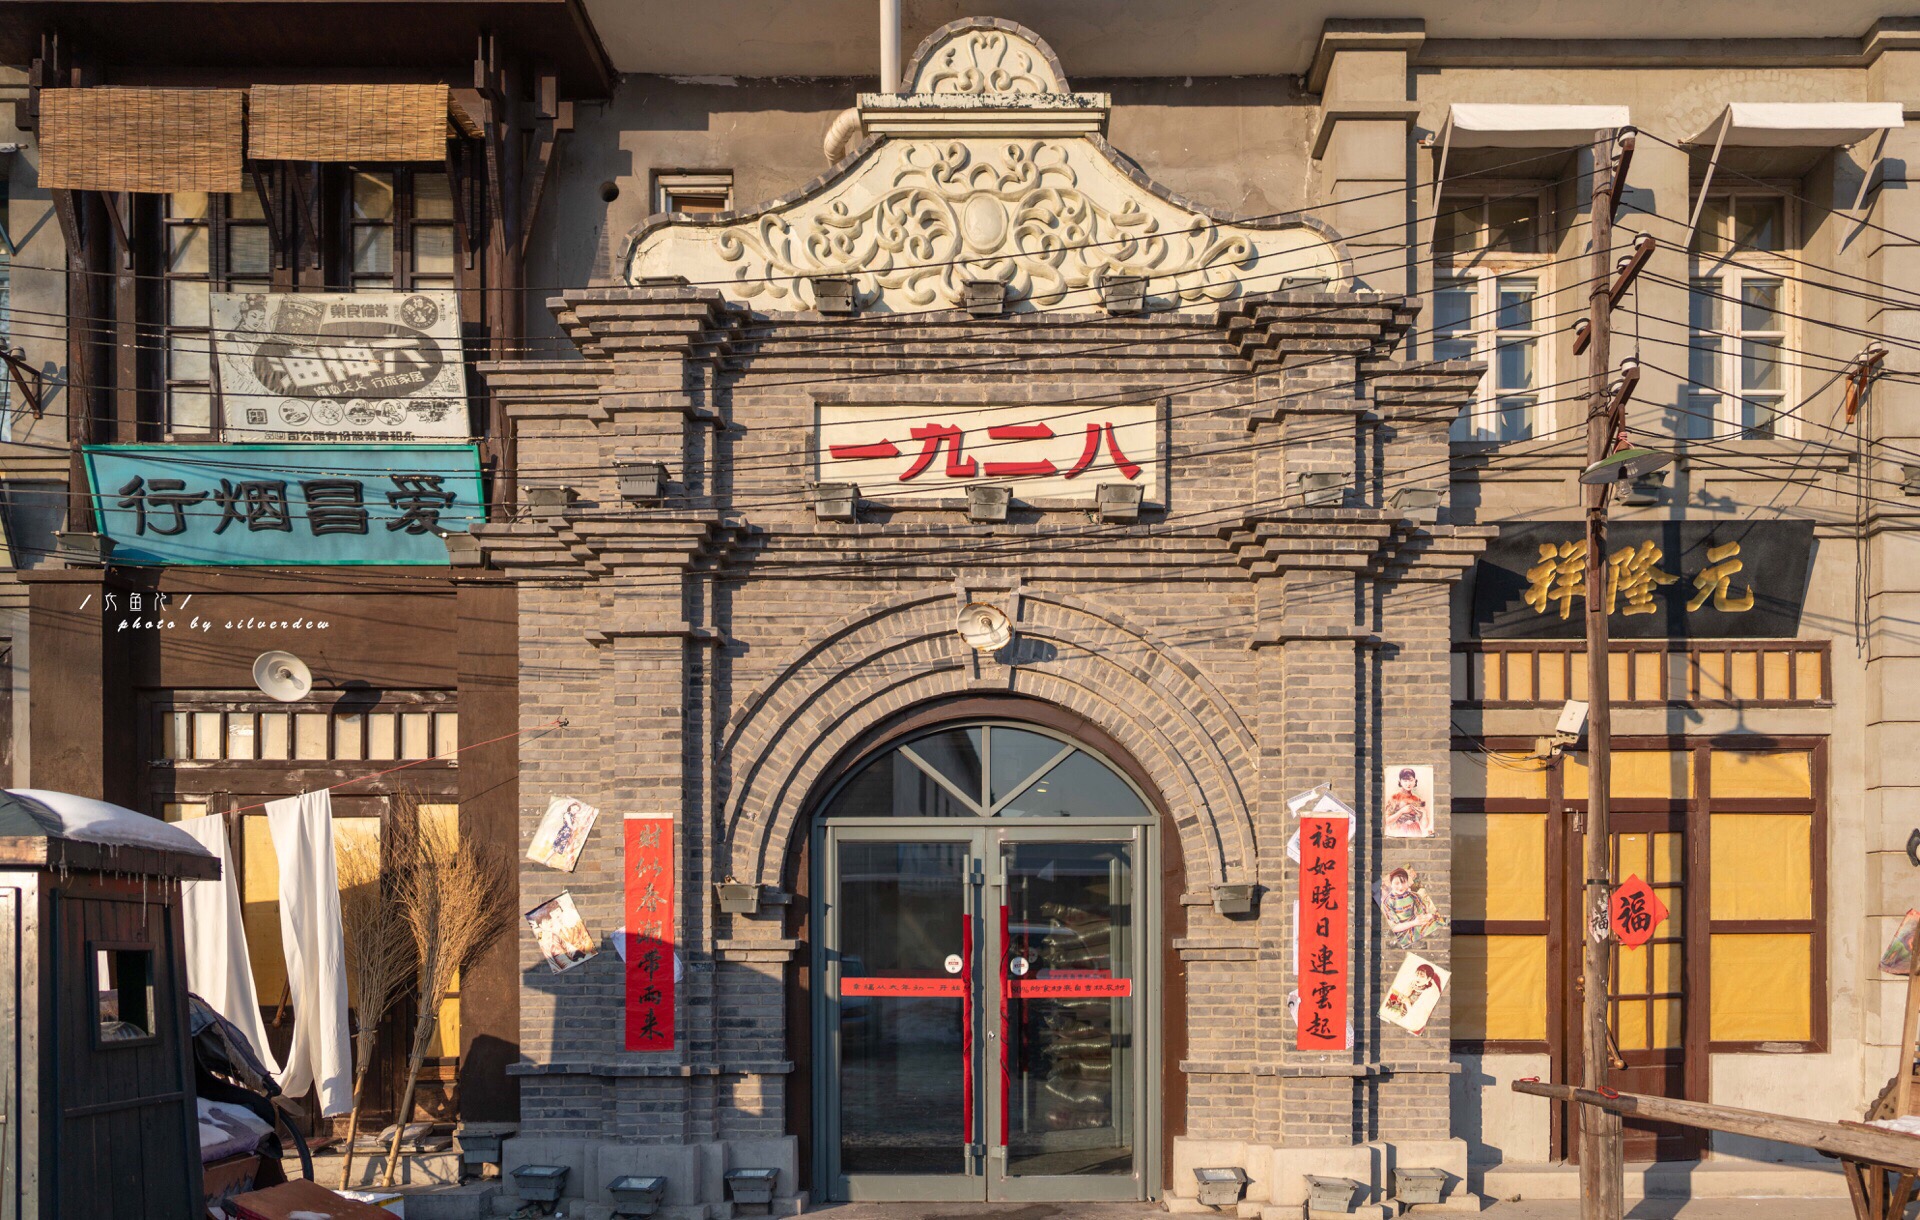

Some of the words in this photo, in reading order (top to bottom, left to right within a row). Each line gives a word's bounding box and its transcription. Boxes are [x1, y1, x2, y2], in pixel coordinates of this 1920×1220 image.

[828, 422, 1142, 481] 一九二八
[1524, 539, 1755, 621] 元隆祥
[1591, 910, 1609, 931] 福
[1617, 890, 1652, 934] 福
